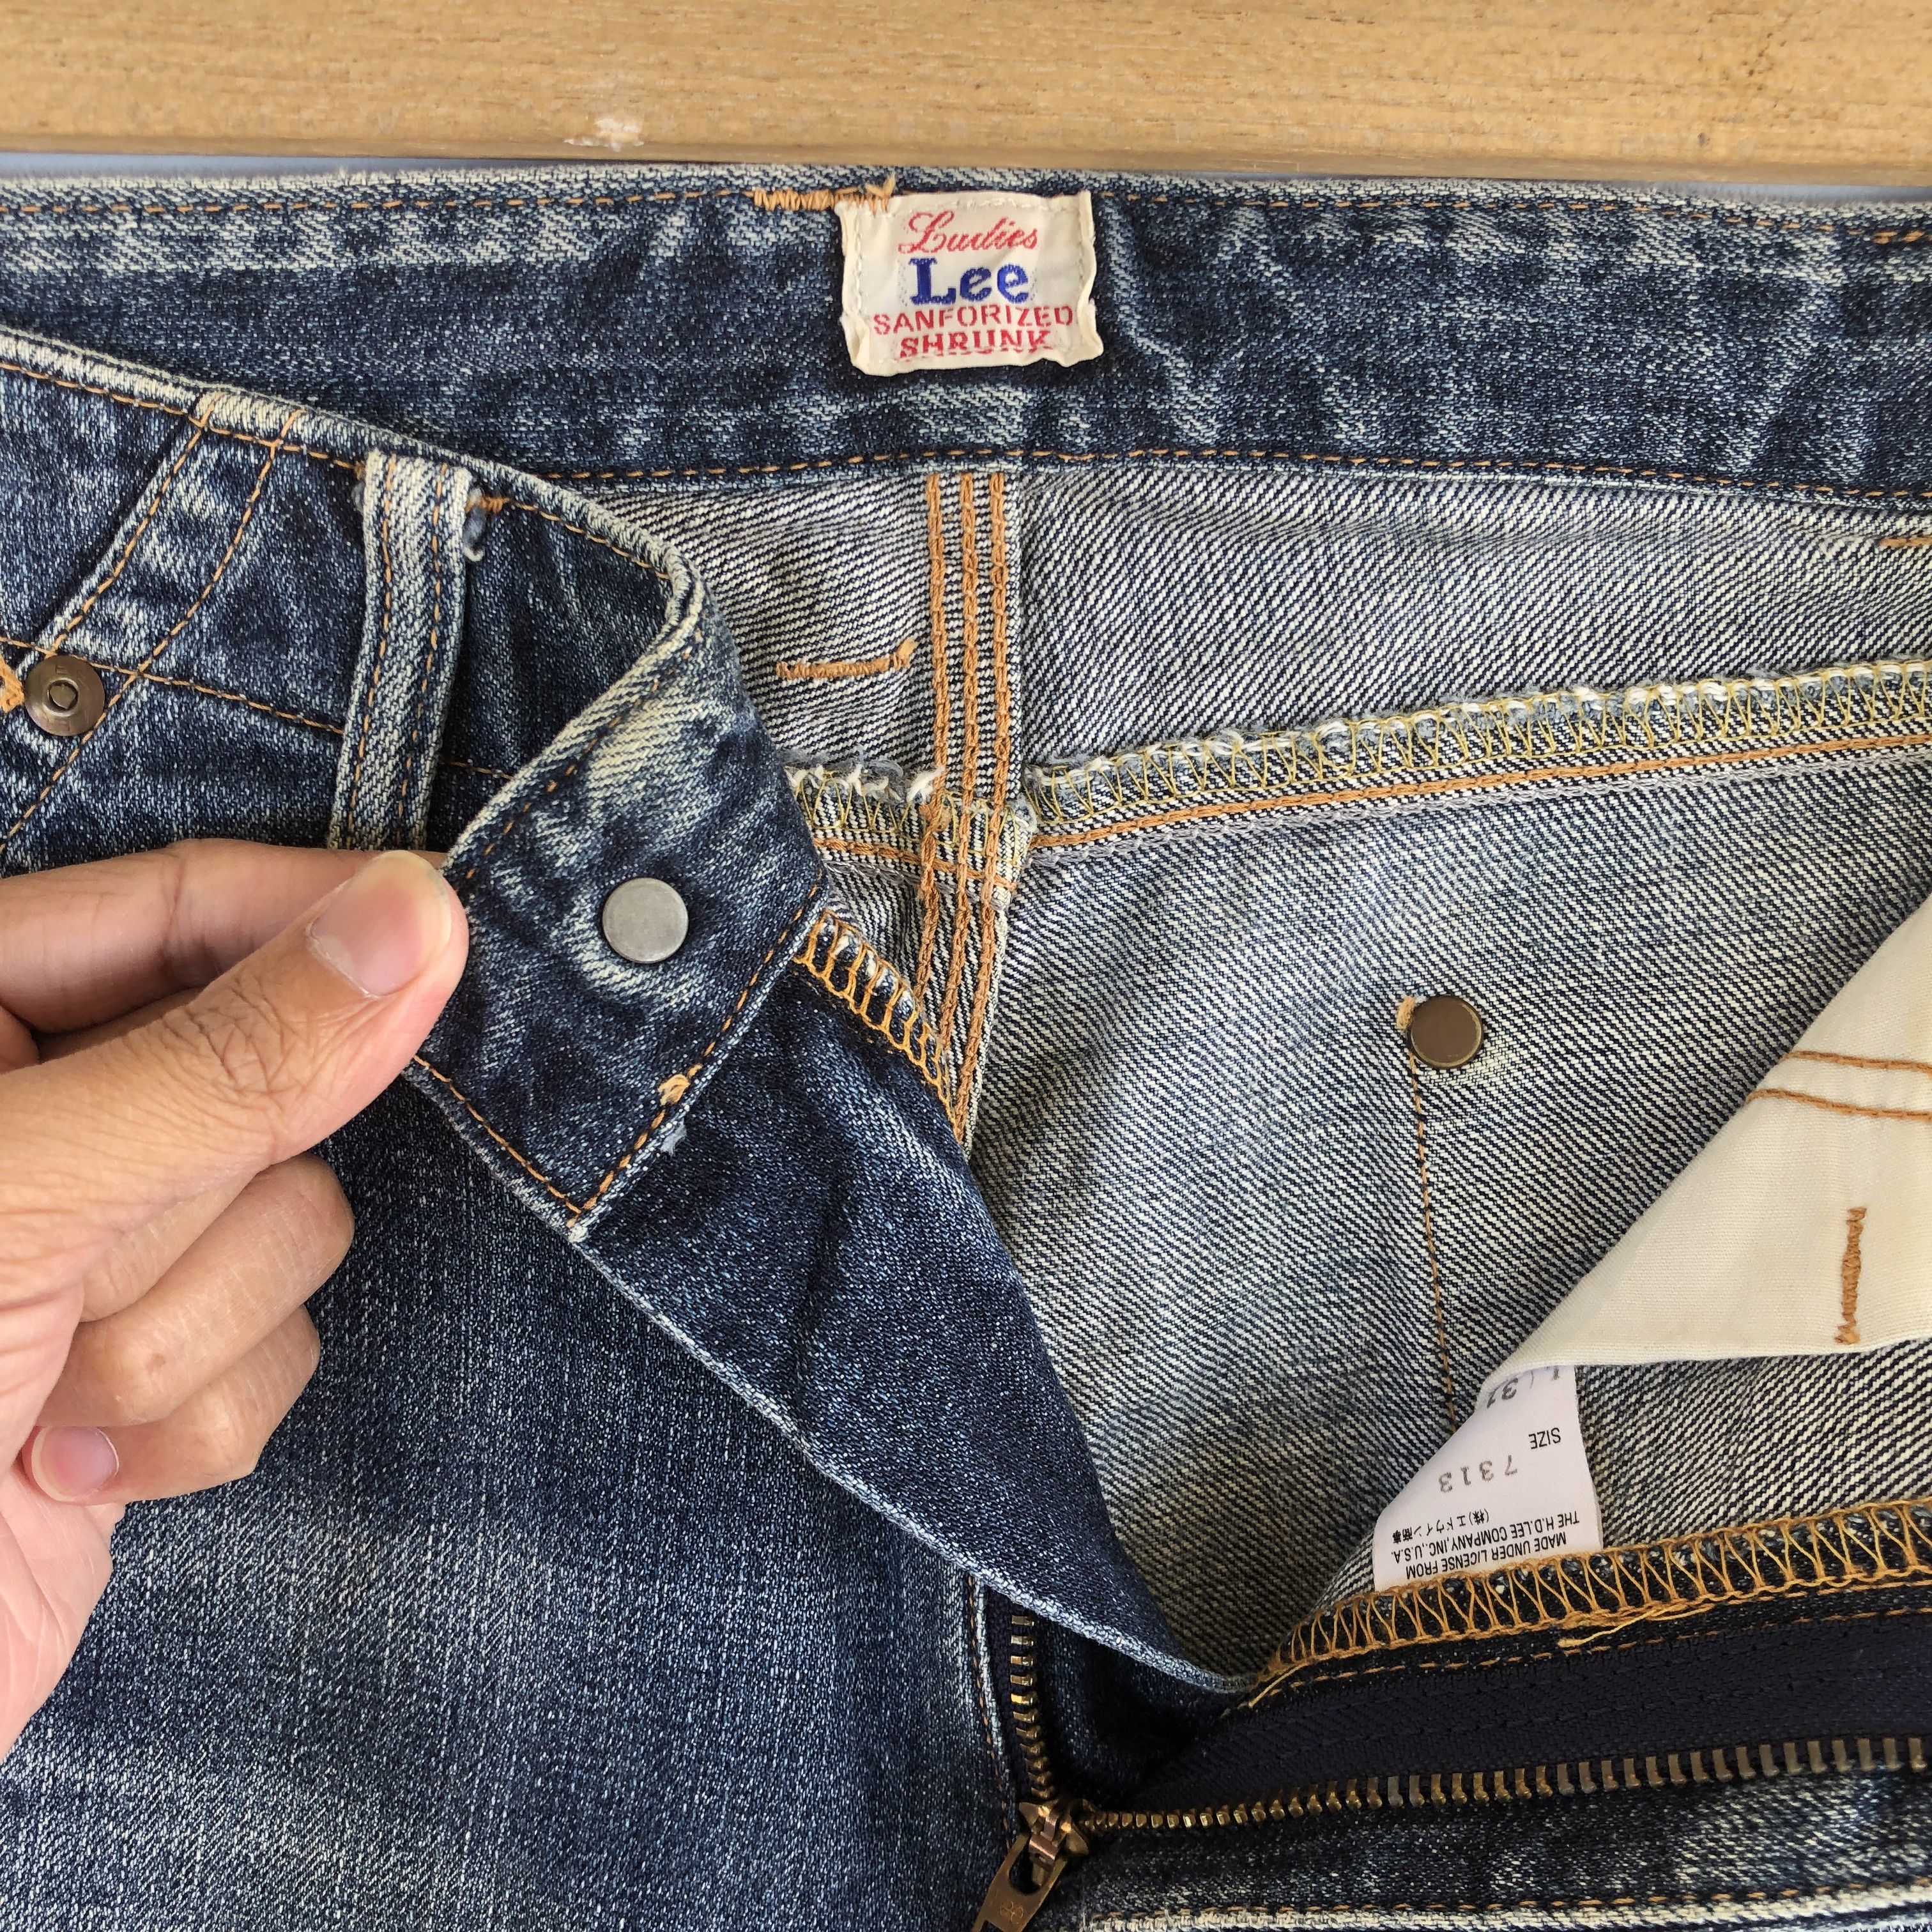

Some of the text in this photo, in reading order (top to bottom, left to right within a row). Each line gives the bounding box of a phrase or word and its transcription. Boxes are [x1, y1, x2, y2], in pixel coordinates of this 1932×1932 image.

[908, 257, 1029, 305] Lee
[873, 304, 1074, 335] SANFORIZED
[899, 330, 1054, 358] SHRUNK
[1528, 1427, 1561, 1449] SIZE
[1438, 1454, 1518, 1493] 7313
[1510, 1517, 1554, 1538] H.D.LEE
[1558, 1511, 1579, 1528] THE
[1406, 1531, 1567, 1580] MADE UNDER LICENSE FROM
